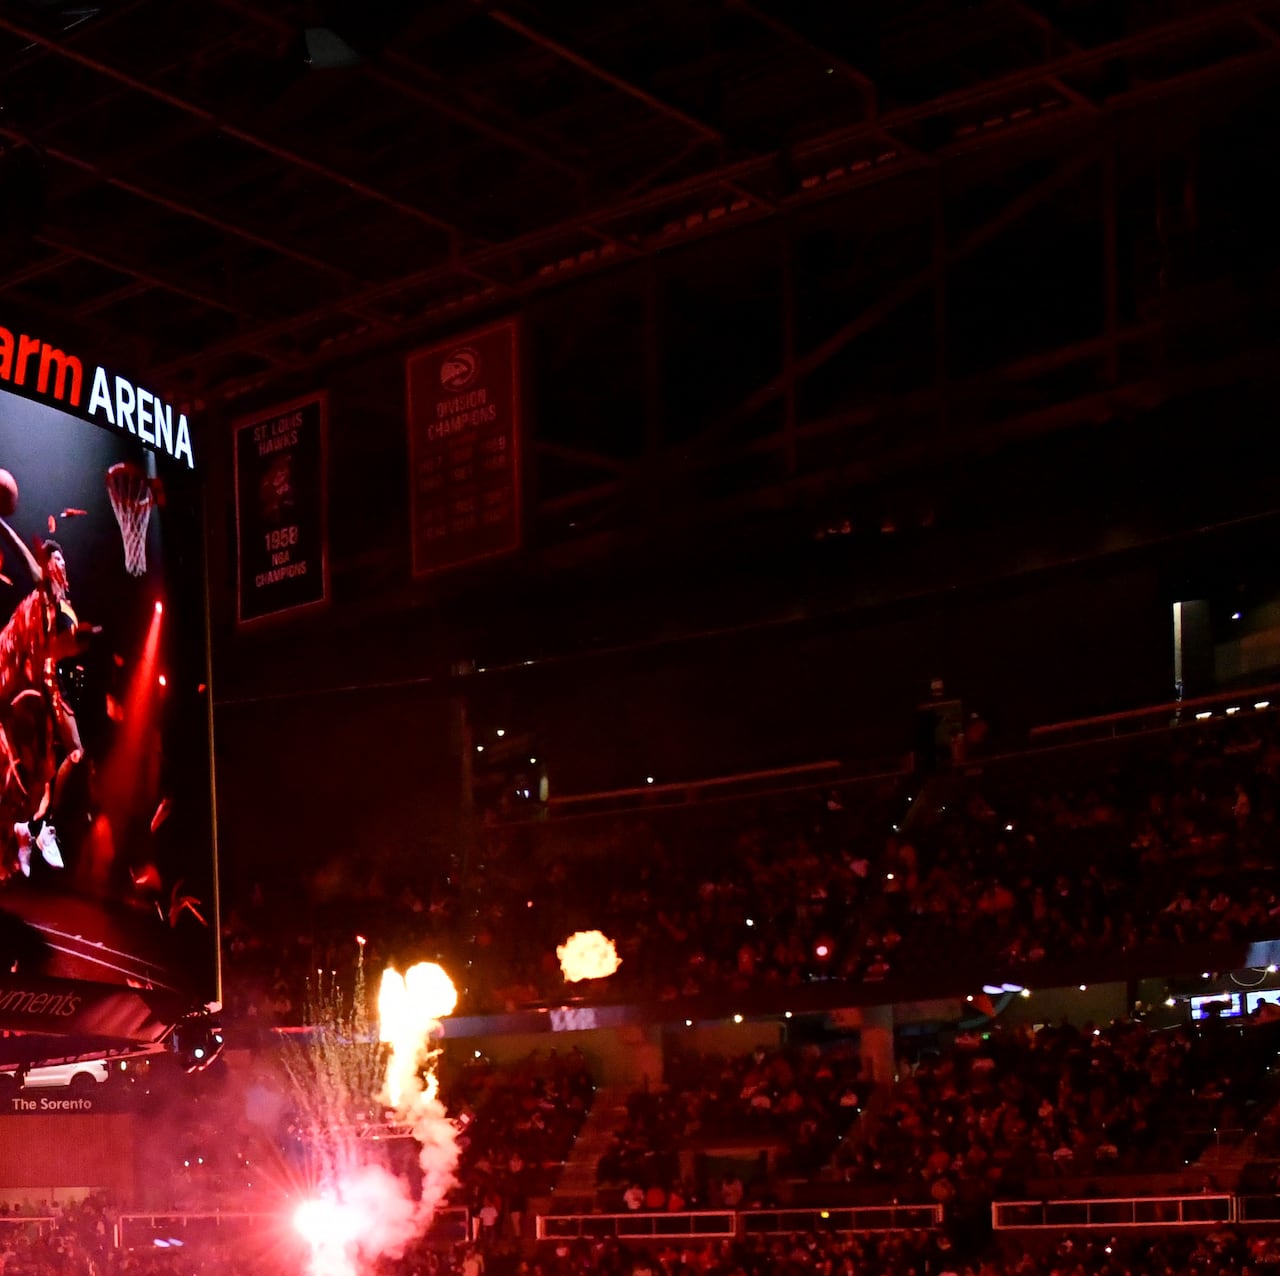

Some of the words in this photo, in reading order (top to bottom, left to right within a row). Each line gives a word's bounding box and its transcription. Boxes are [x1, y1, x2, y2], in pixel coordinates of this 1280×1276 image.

[88, 366, 195, 469] ARENA
[255, 560, 308, 588] CHAMPIONS
[12, 1098, 37, 1110] The
[40, 1097, 92, 1110] Sorento
